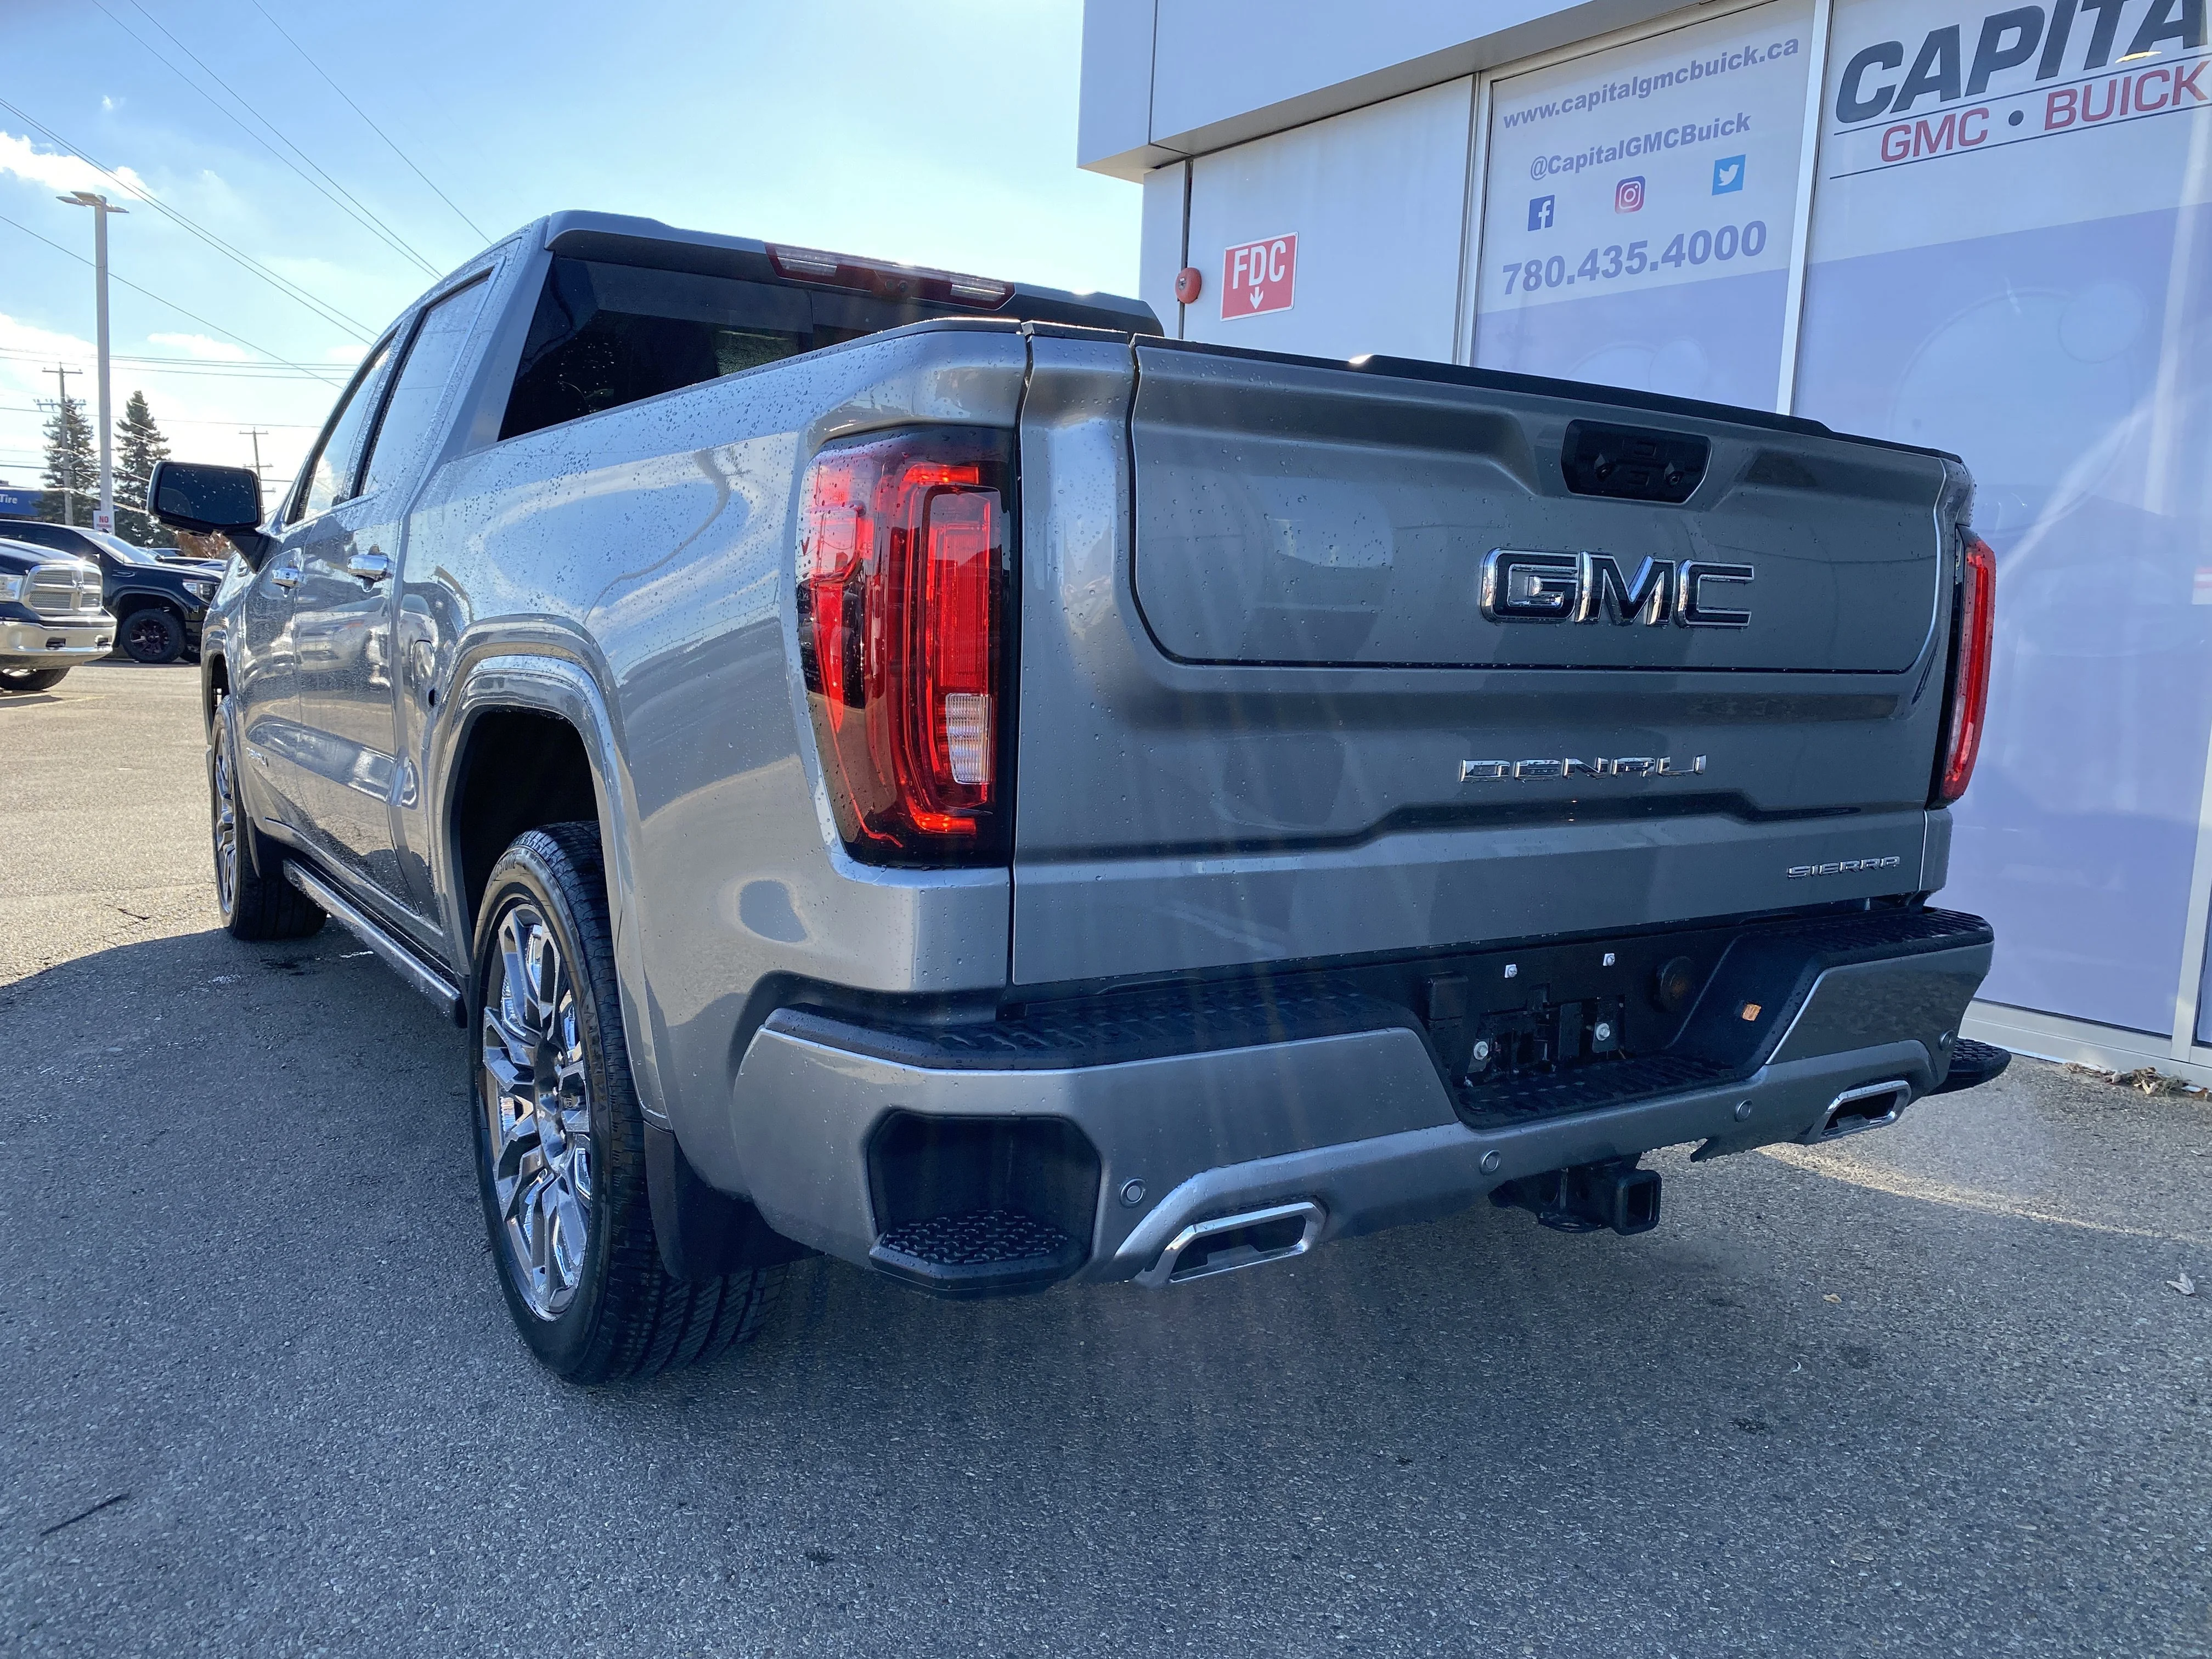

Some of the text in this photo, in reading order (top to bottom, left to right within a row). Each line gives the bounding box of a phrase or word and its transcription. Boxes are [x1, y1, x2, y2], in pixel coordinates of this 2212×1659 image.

[1503, 38, 1799, 129] www.capitalgmcbuick.ca
[1881, 60, 2211, 162] GMC BUICK
[1531, 112, 1751, 180] @CapitalGMCBuick
[1233, 240, 1286, 289] FDC
[1503, 220, 1767, 295] 780.435.4000
[1481, 547, 1754, 628] GMC
[1459, 754, 1707, 783] DENALI
[1787, 855, 1901, 879] SIERRA
